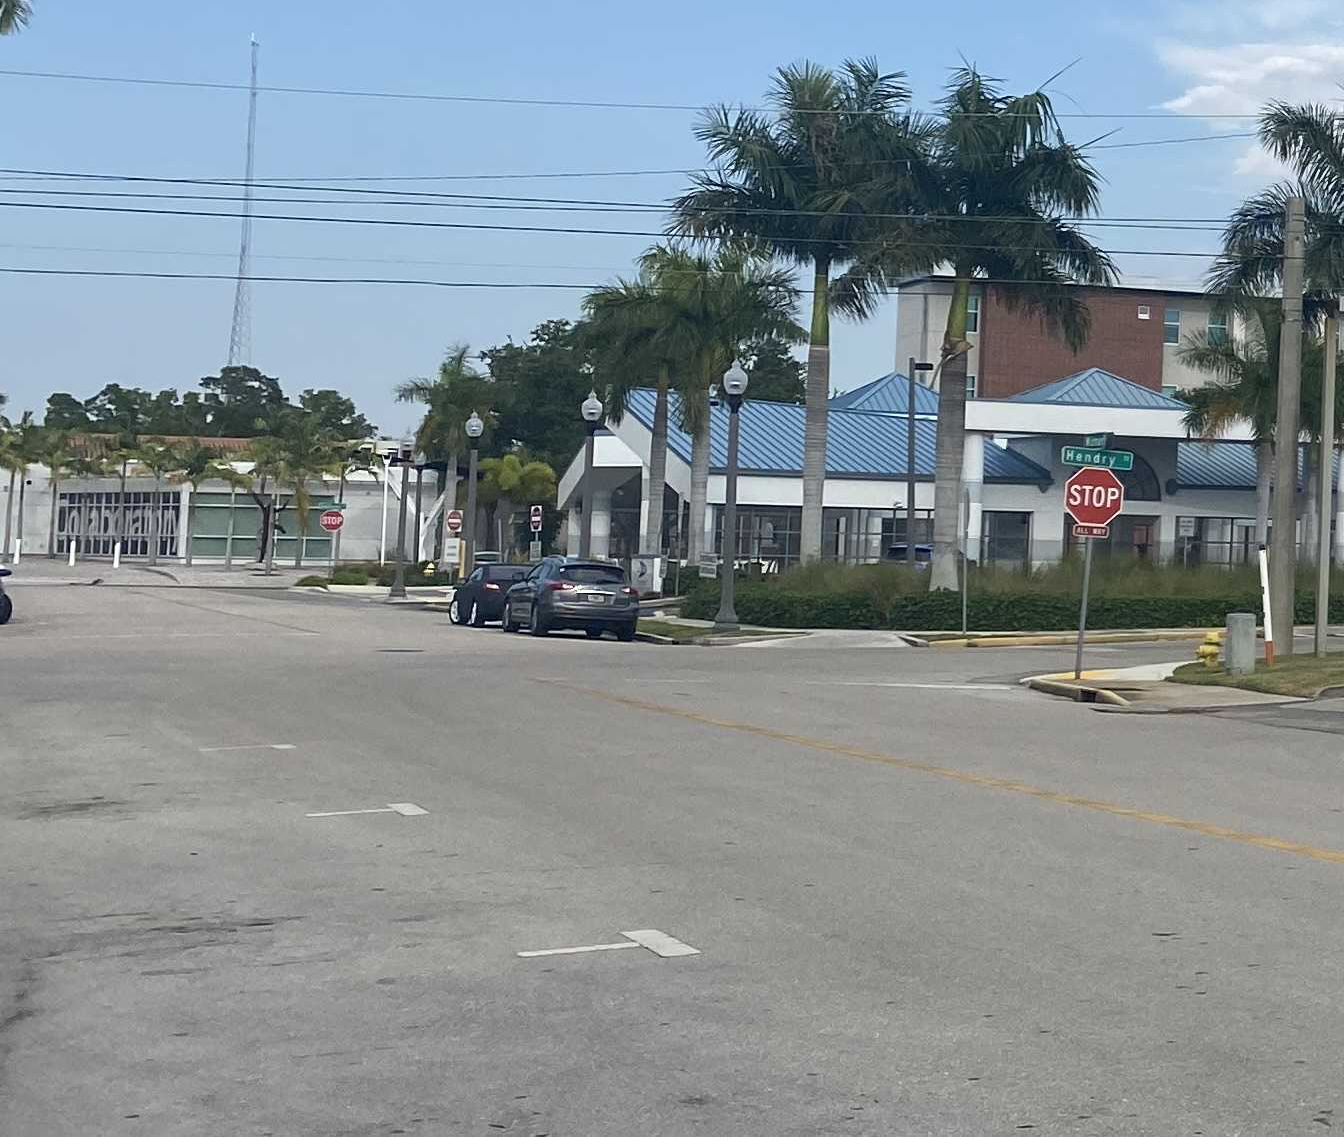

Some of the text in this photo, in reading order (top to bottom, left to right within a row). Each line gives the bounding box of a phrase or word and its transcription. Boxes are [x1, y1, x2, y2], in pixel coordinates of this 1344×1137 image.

[1066, 449, 1116, 468] Hendry
[1069, 484, 1120, 508] STOP
[321, 516, 343, 525] STOP
